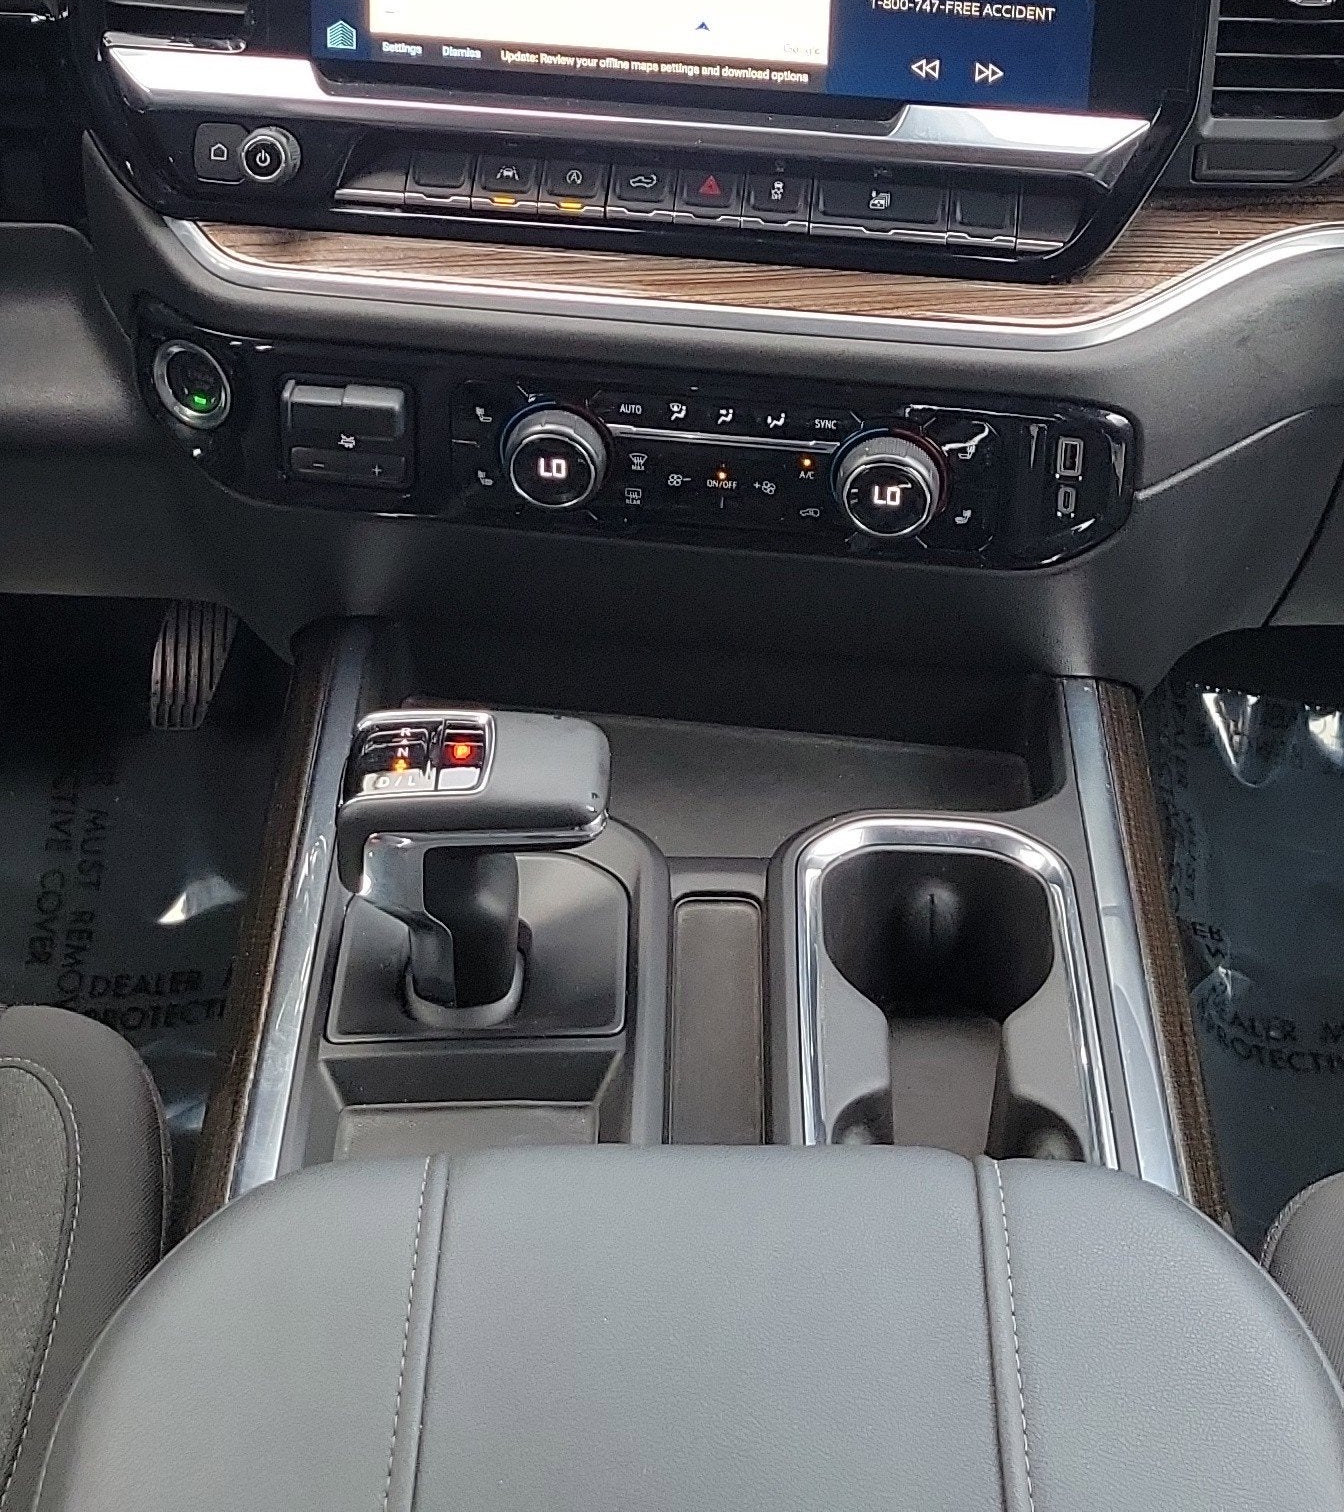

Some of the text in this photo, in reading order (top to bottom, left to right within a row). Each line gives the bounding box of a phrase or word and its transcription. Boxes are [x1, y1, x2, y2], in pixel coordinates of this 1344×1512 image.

[982, 2, 1056, 22] ACCIDENT
[382, 41, 423, 56] Settings
[500, 49, 809, 83] Update: Review your offline maps settings and download options
[619, 403, 642, 415] AUTO
[814, 418, 837, 430] SYNC
[537, 456, 568, 479] LO
[799, 470, 814, 480] A/C
[706, 479, 738, 490] ON/OFF
[873, 485, 901, 506] LO
[400, 727, 411, 736] R
[397, 746, 409, 757] N
[77, 807, 110, 891] MUST
[25, 869, 66, 969] COVER
[57, 909, 96, 1010] REMOV
[88, 969, 203, 999] DEALER
